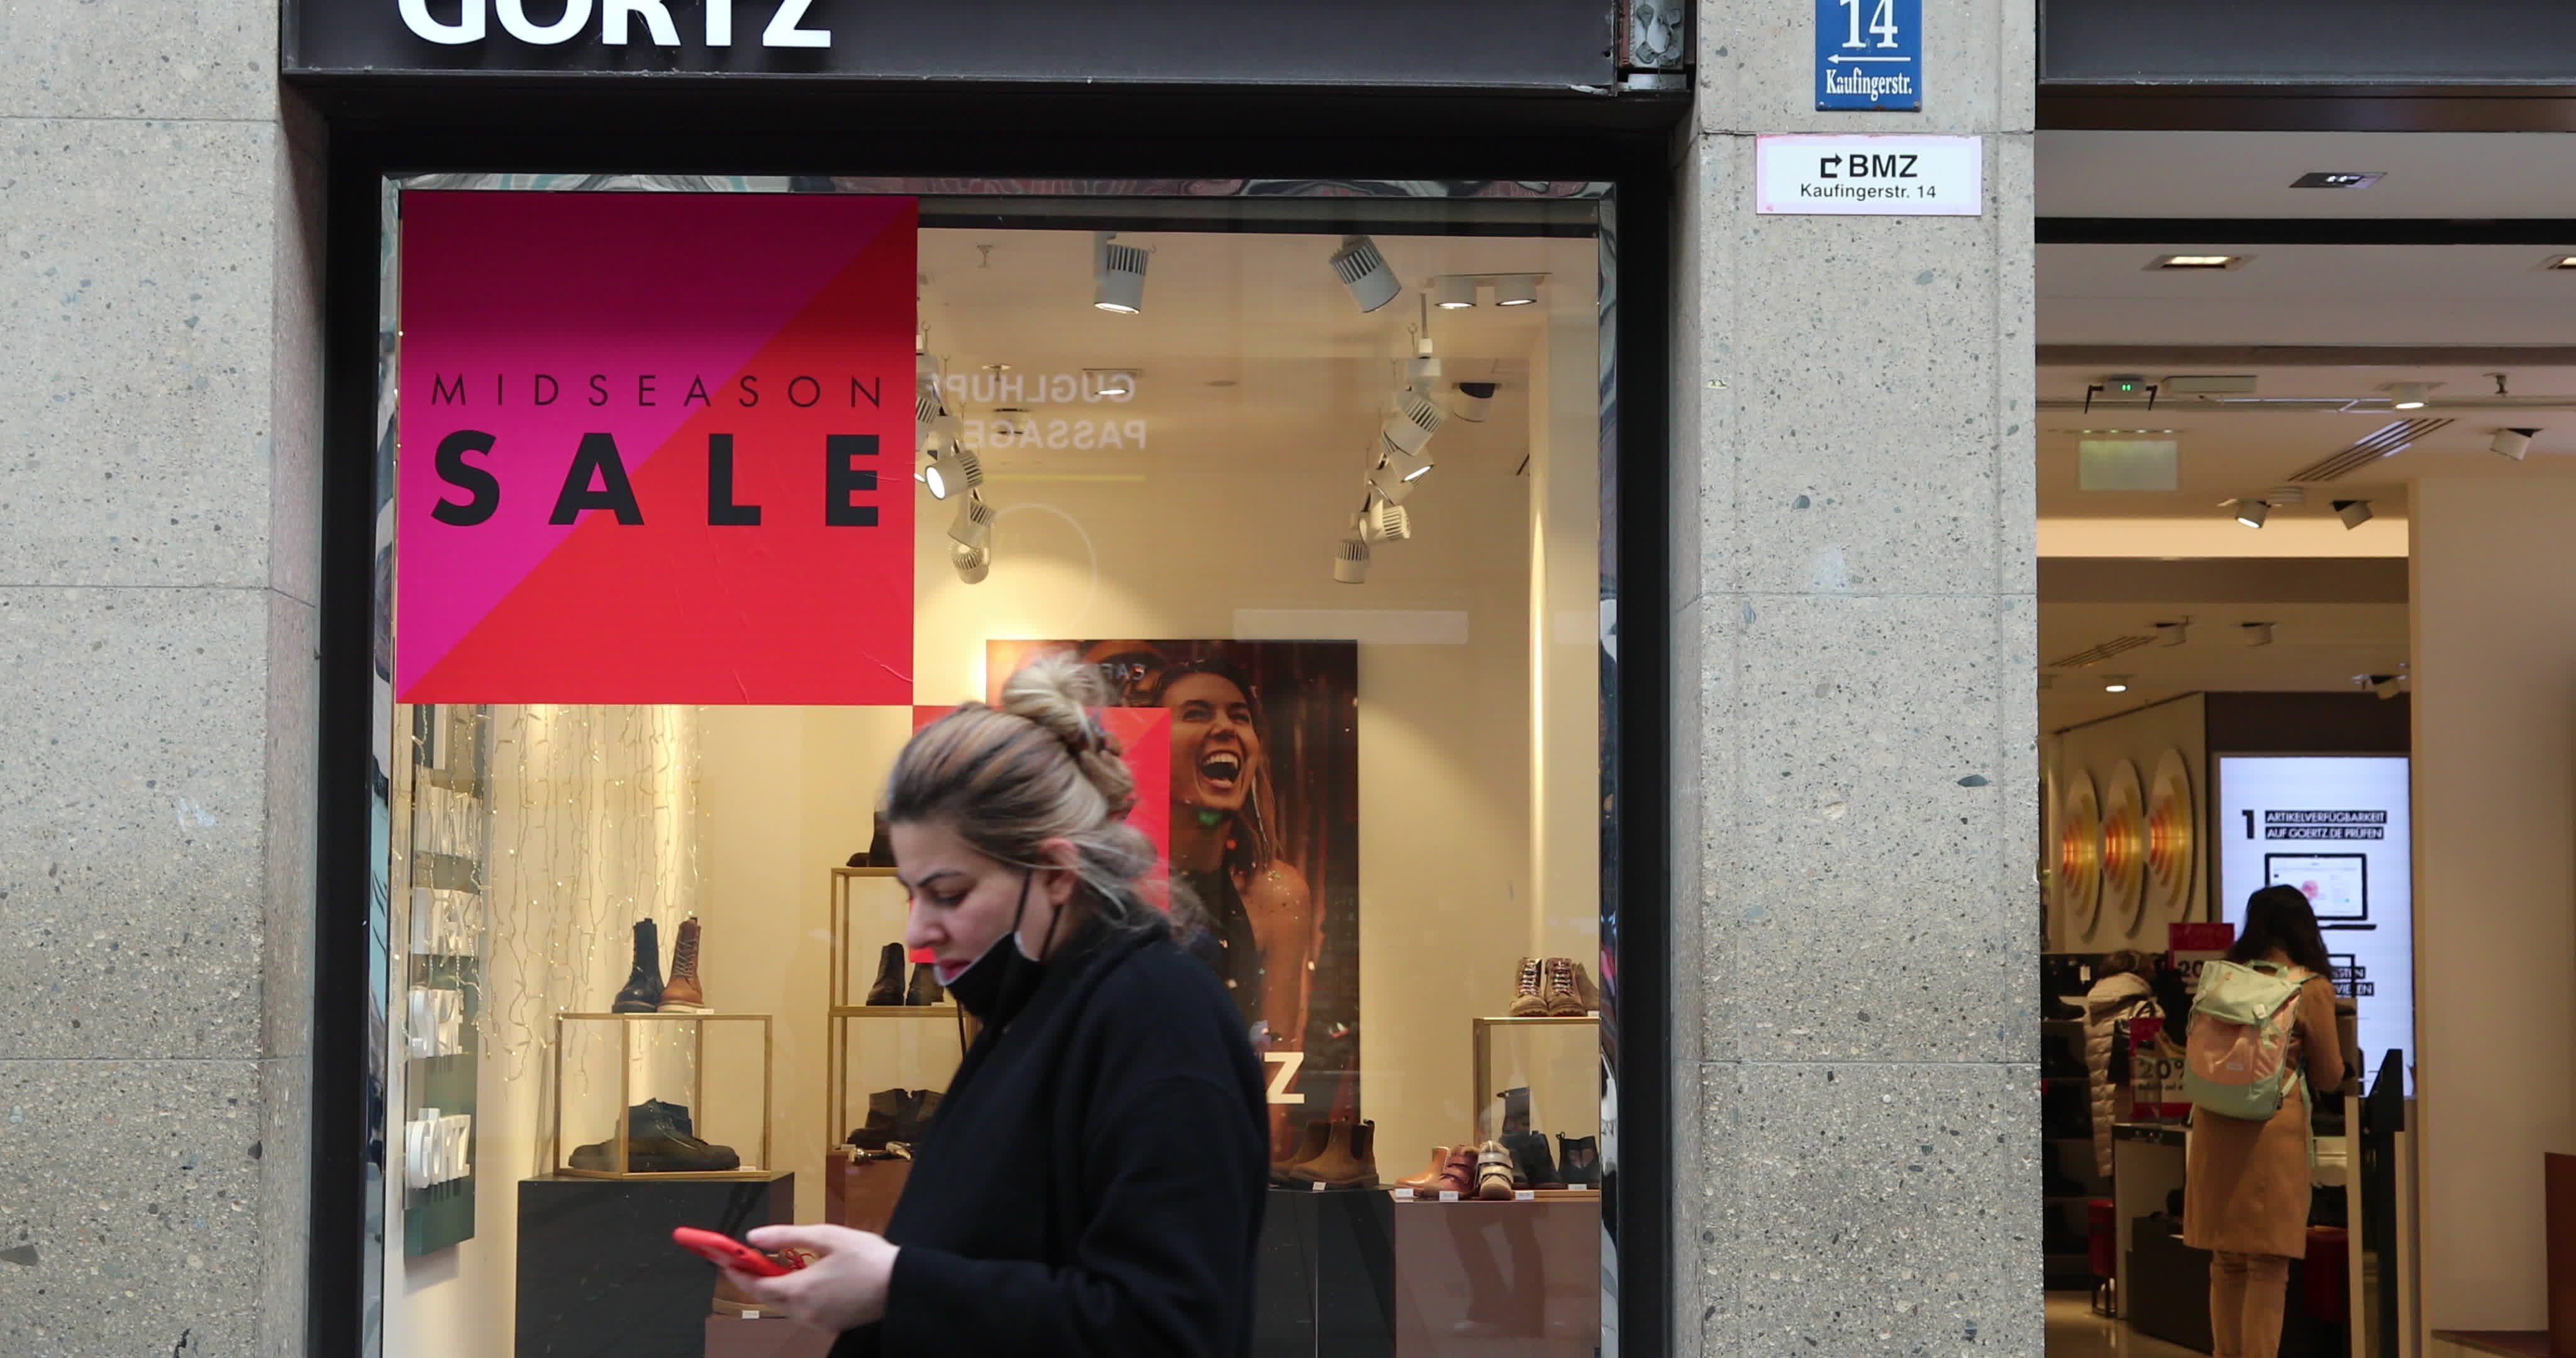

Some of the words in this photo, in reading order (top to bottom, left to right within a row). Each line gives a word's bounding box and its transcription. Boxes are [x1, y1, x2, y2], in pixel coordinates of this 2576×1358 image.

[1840, 0, 1898, 48] 14
[1826, 67, 1913, 101] Kaufingerstr.
[1850, 154, 1918, 178] BMZ
[1801, 183, 1909, 202] Kaufingerstr.
[1918, 185, 1936, 198] 14
[431, 372, 880, 407] MIDSEASON
[431, 429, 879, 527] SALE
[2241, 809, 2255, 839] 1
[2267, 828, 2287, 838] AUF
[2344, 827, 2382, 838] PRÜFEN
